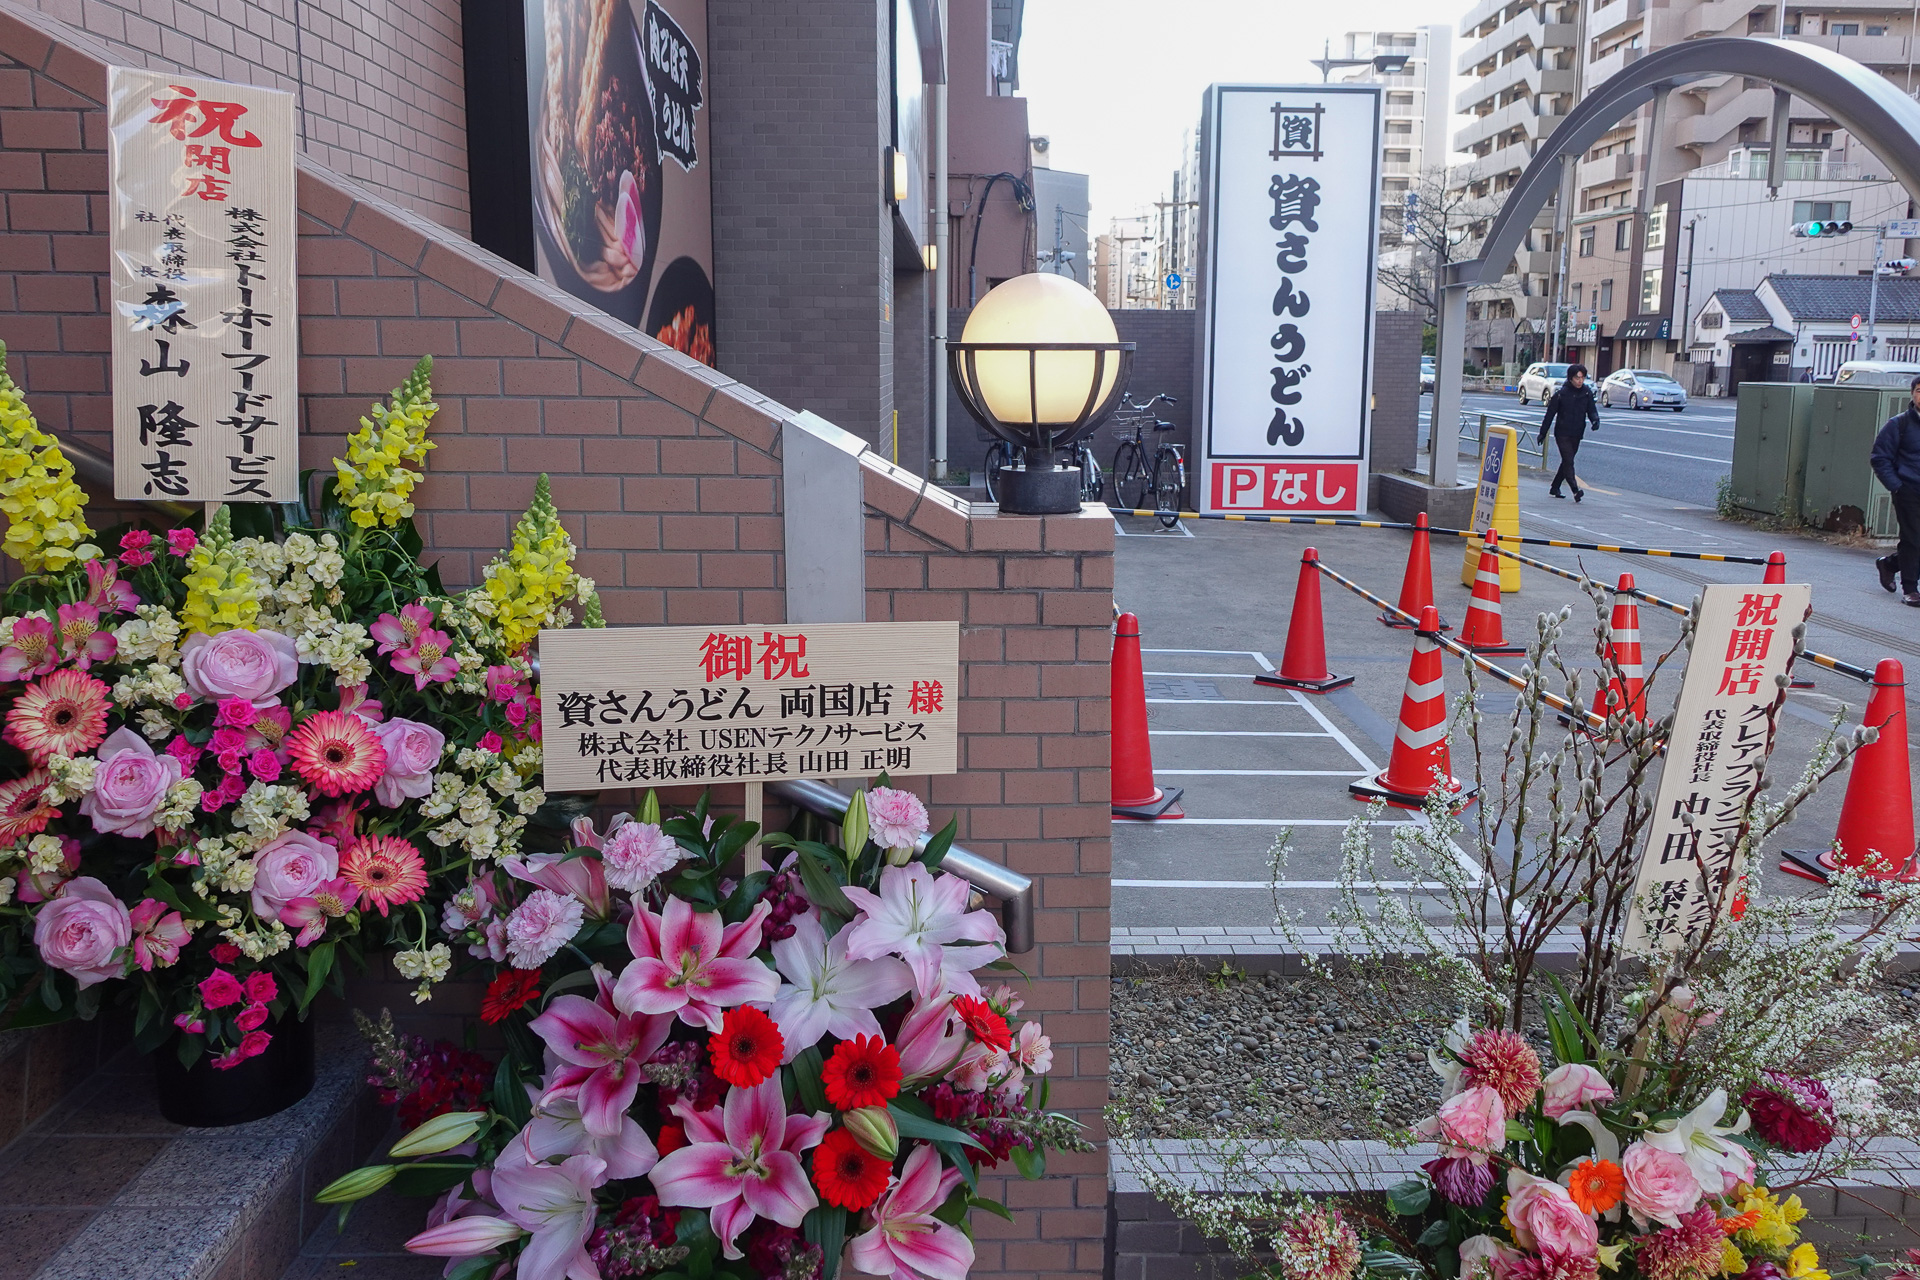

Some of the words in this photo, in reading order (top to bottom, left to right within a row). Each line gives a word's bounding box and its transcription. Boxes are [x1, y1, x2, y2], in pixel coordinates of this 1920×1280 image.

[150, 85, 262, 148] 祝
[662, 92, 691, 155] うどん
[1281, 115, 1313, 150] 資
[181, 143, 232, 202] 開店
[161, 213, 189, 282] 代表取締役
[1266, 173, 1321, 447] 資さんうどん
[216, 206, 279, 499] 株式会社トーホーフードサービス
[1229, 468, 1258, 506] P
[1270, 468, 1347, 506] なし
[699, 632, 810, 683] 御祝
[1715, 592, 1783, 697] 祝開店
[557, 686, 765, 729] 資さんうどん
[778, 681, 894, 719] 両国店
[907, 680, 944, 715] 様
[577, 728, 689, 757] 株式会社
[700, 721, 928, 752] USENテクノサービス
[596, 750, 788, 784] 代表取締役社長
[799, 750, 849, 773] 山田
[859, 746, 912, 771] 正明
[1688, 708, 1727, 785] 代表取締役社長
